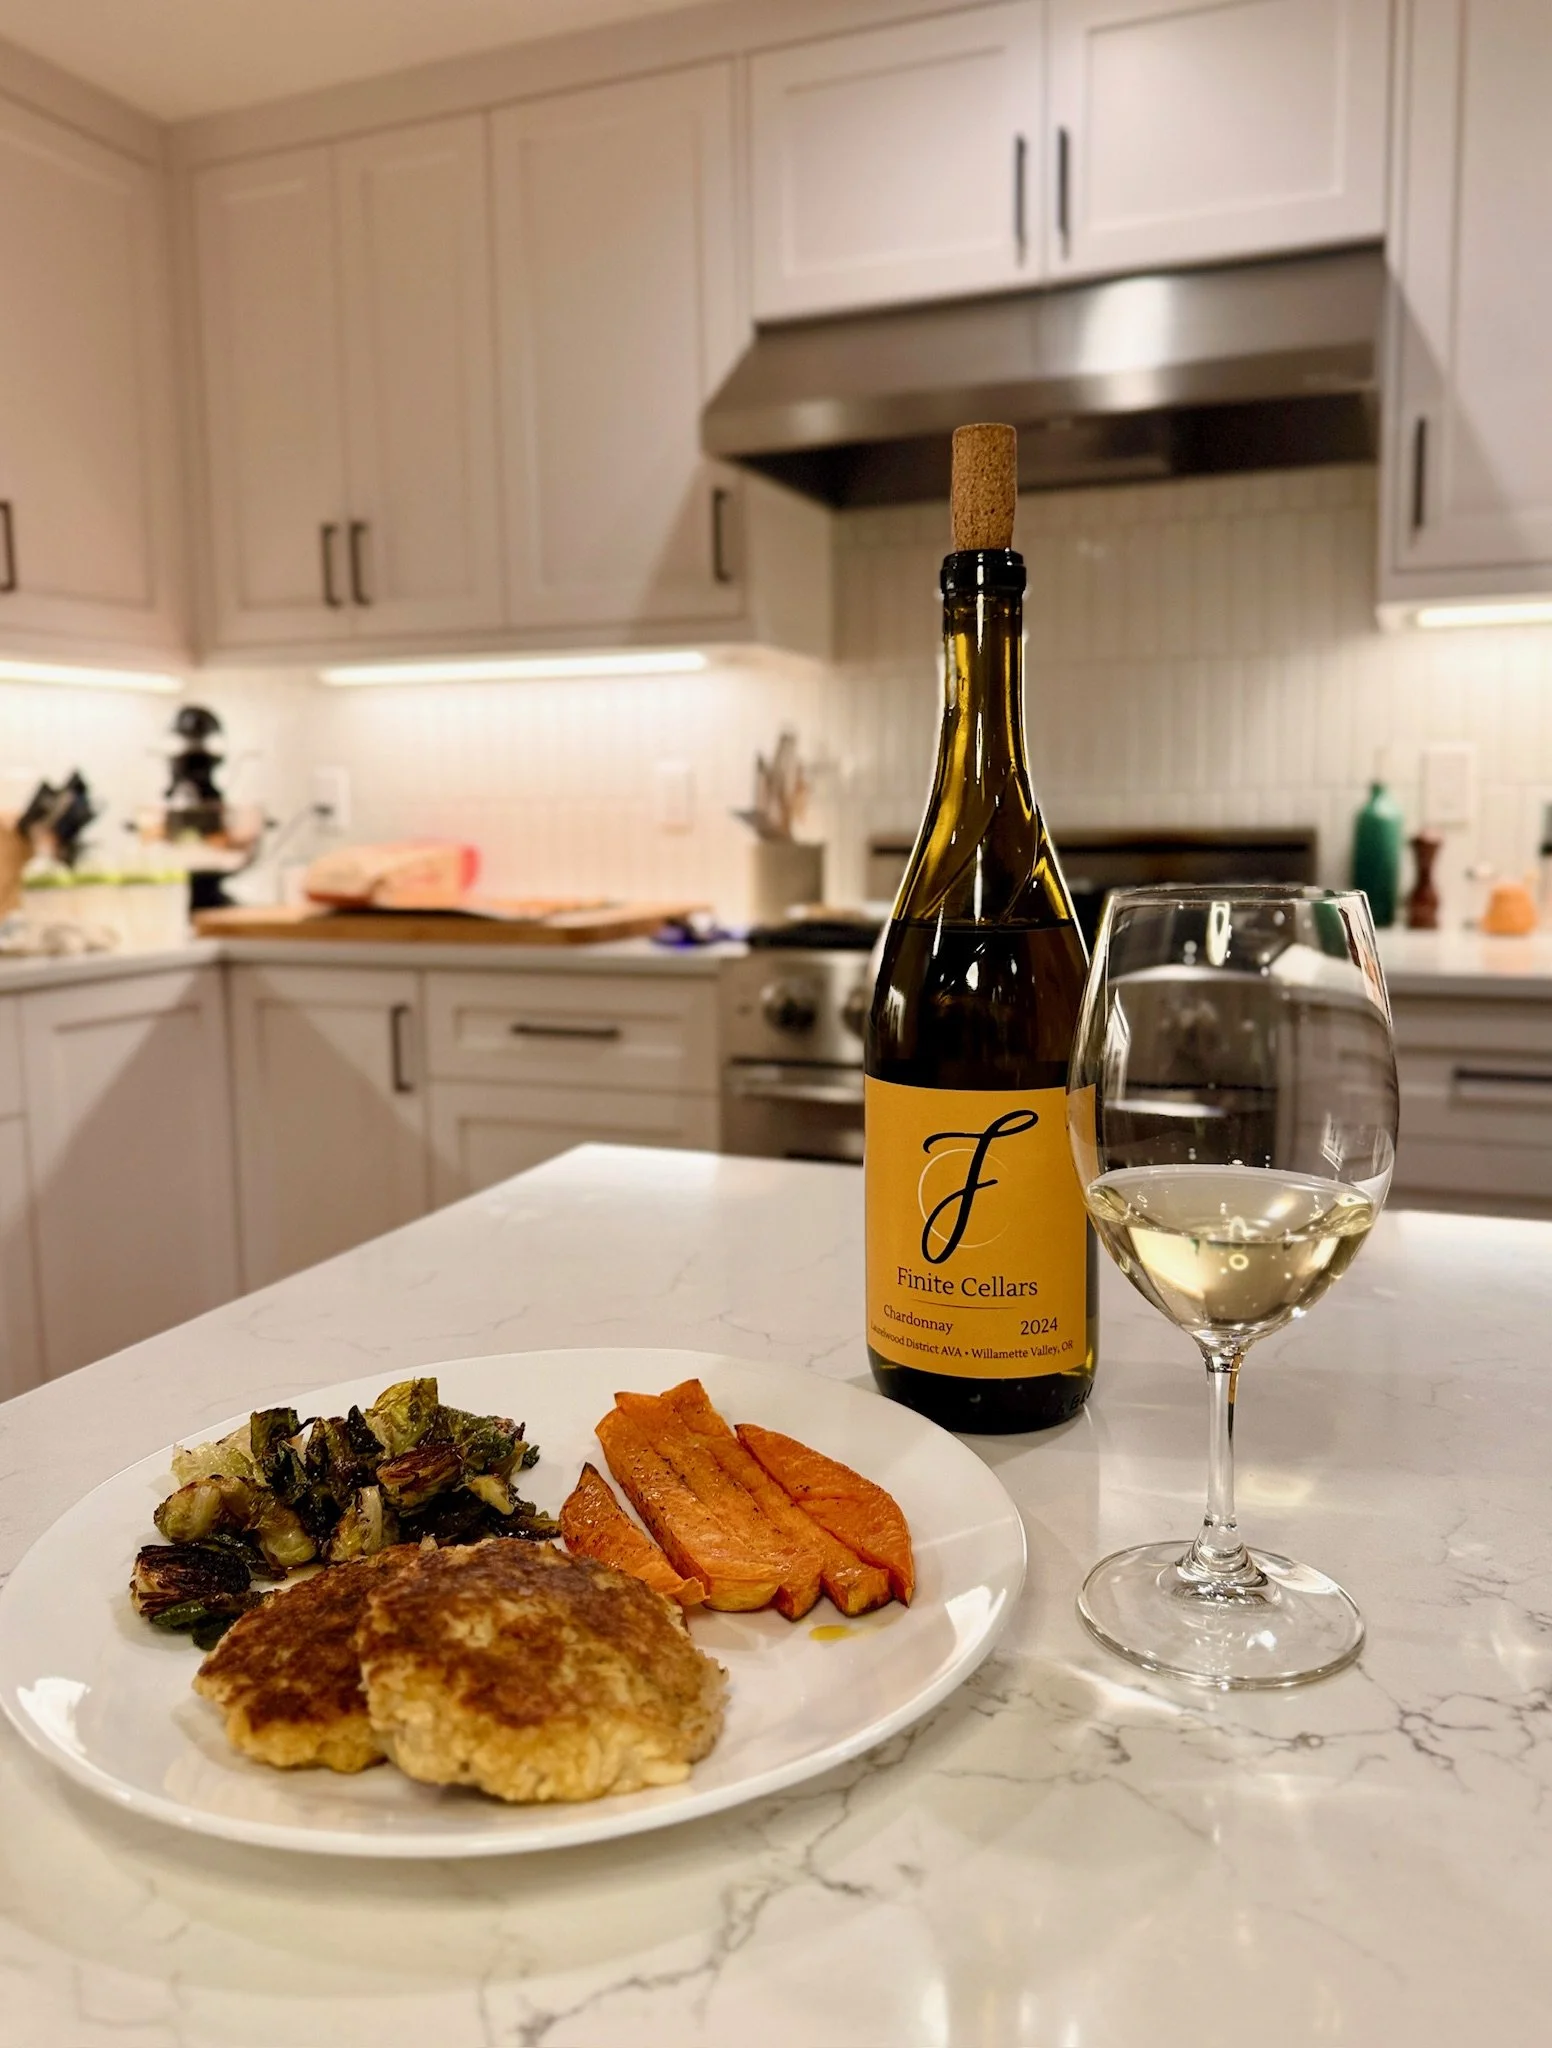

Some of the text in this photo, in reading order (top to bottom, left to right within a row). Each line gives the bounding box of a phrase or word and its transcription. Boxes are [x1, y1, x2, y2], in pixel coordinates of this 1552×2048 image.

[897, 1266, 1038, 1297] Finite Cellars
[883, 1304, 953, 1335] Chardonnay
[1020, 1317, 1058, 1335] 2024
[906, 1337, 939, 1355] District
[941, 1345, 962, 1357] AVA
[971, 1348, 1028, 1359] Willamette
[1030, 1344, 1060, 1356] Valley,
[1061, 1339, 1073, 1351] OR
